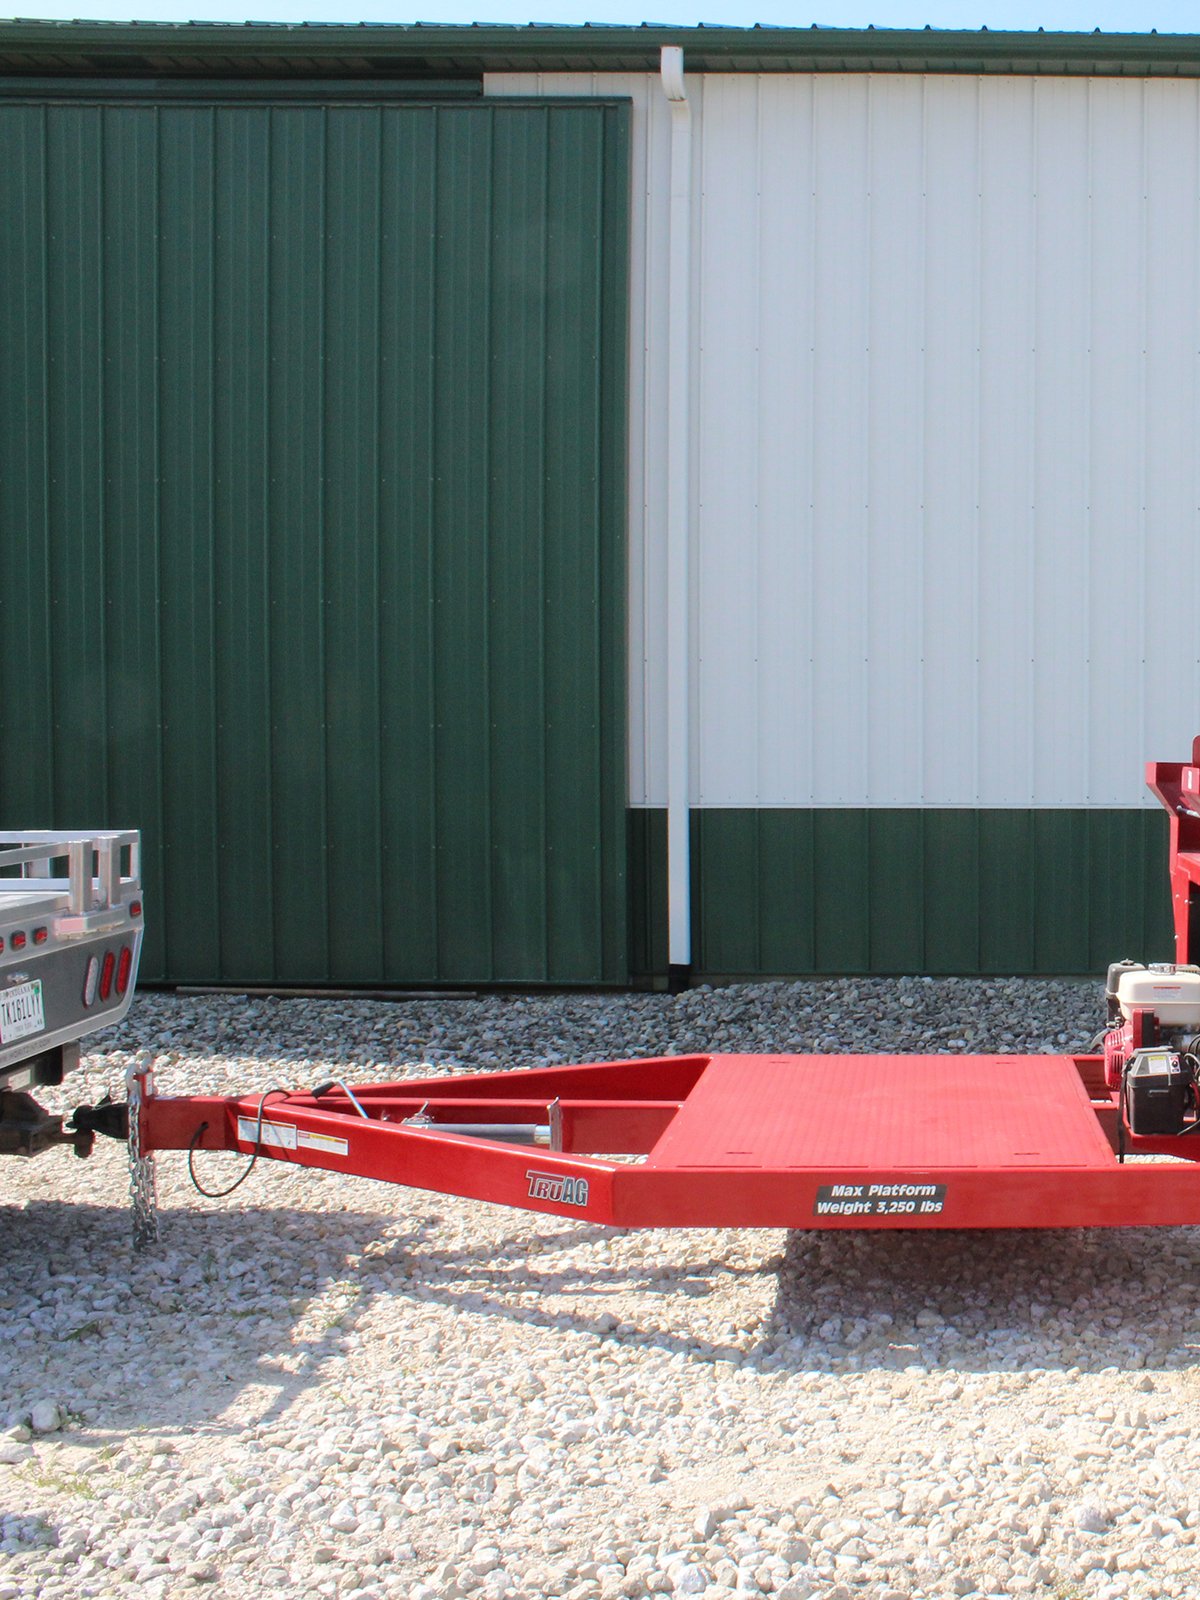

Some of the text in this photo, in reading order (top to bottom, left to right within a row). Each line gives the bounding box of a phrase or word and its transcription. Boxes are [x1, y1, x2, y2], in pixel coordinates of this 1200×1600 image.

[831, 1184, 936, 1196] Max Platform
[817, 1201, 871, 1215] Weight
[876, 1201, 916, 1214] 3,250
